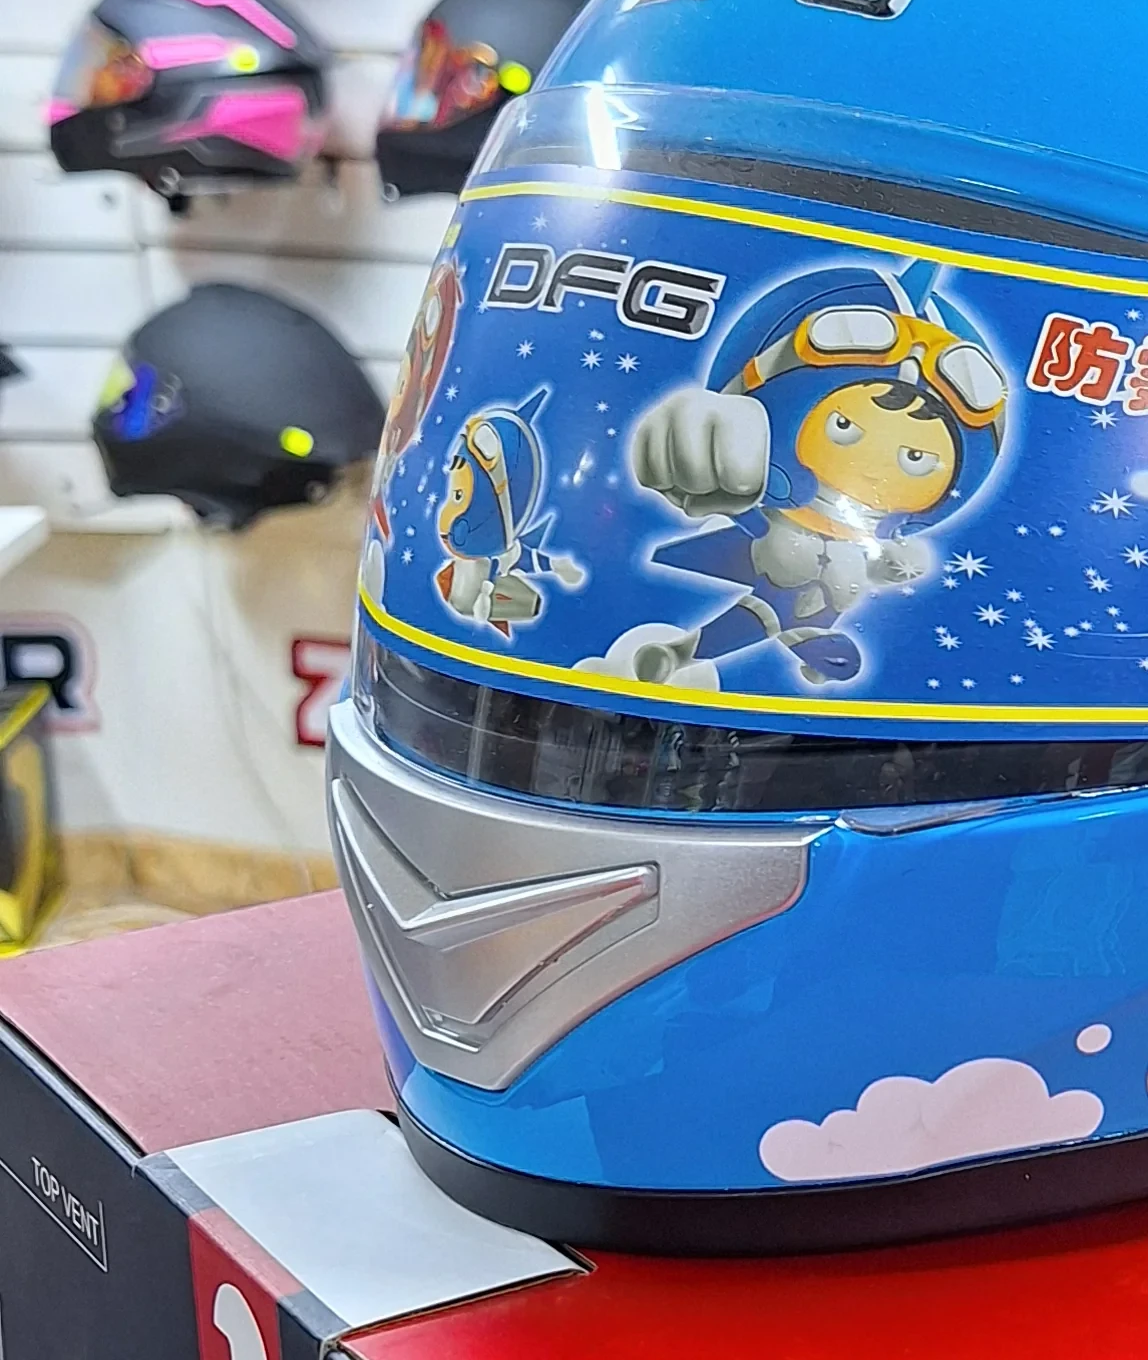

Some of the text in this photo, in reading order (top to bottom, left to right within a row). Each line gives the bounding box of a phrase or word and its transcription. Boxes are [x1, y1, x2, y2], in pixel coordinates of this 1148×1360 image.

[485, 243, 726, 341] DFG
[31, 1156, 99, 1246] TOP VENT
